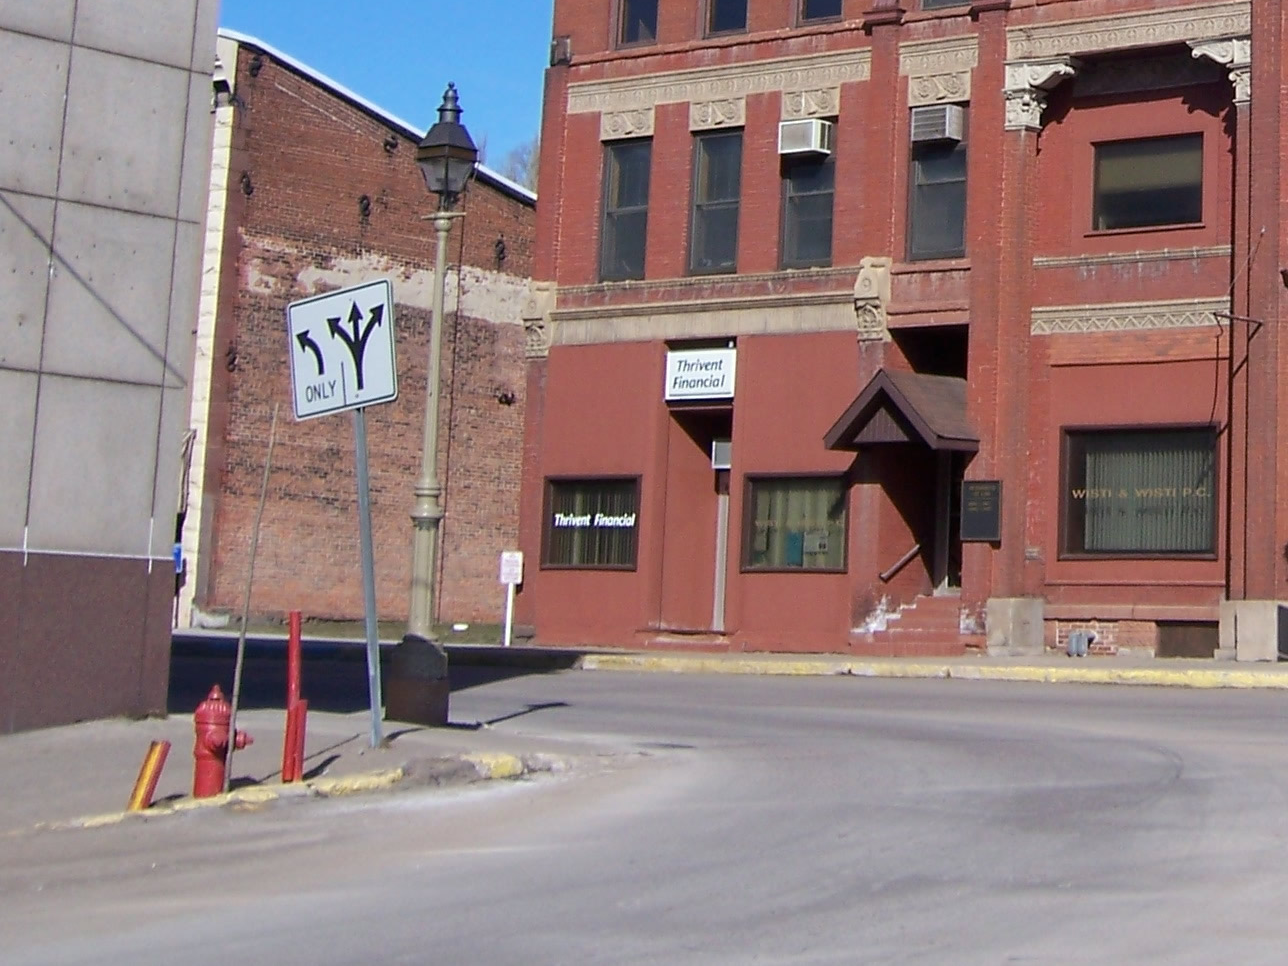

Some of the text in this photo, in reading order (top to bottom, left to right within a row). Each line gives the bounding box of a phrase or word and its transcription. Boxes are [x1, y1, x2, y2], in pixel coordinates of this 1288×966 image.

[677, 359, 723, 372] Thrivent
[672, 374, 726, 389] Financial
[305, 379, 337, 403] ONLY
[554, 512, 636, 527] Thrivent Financial
